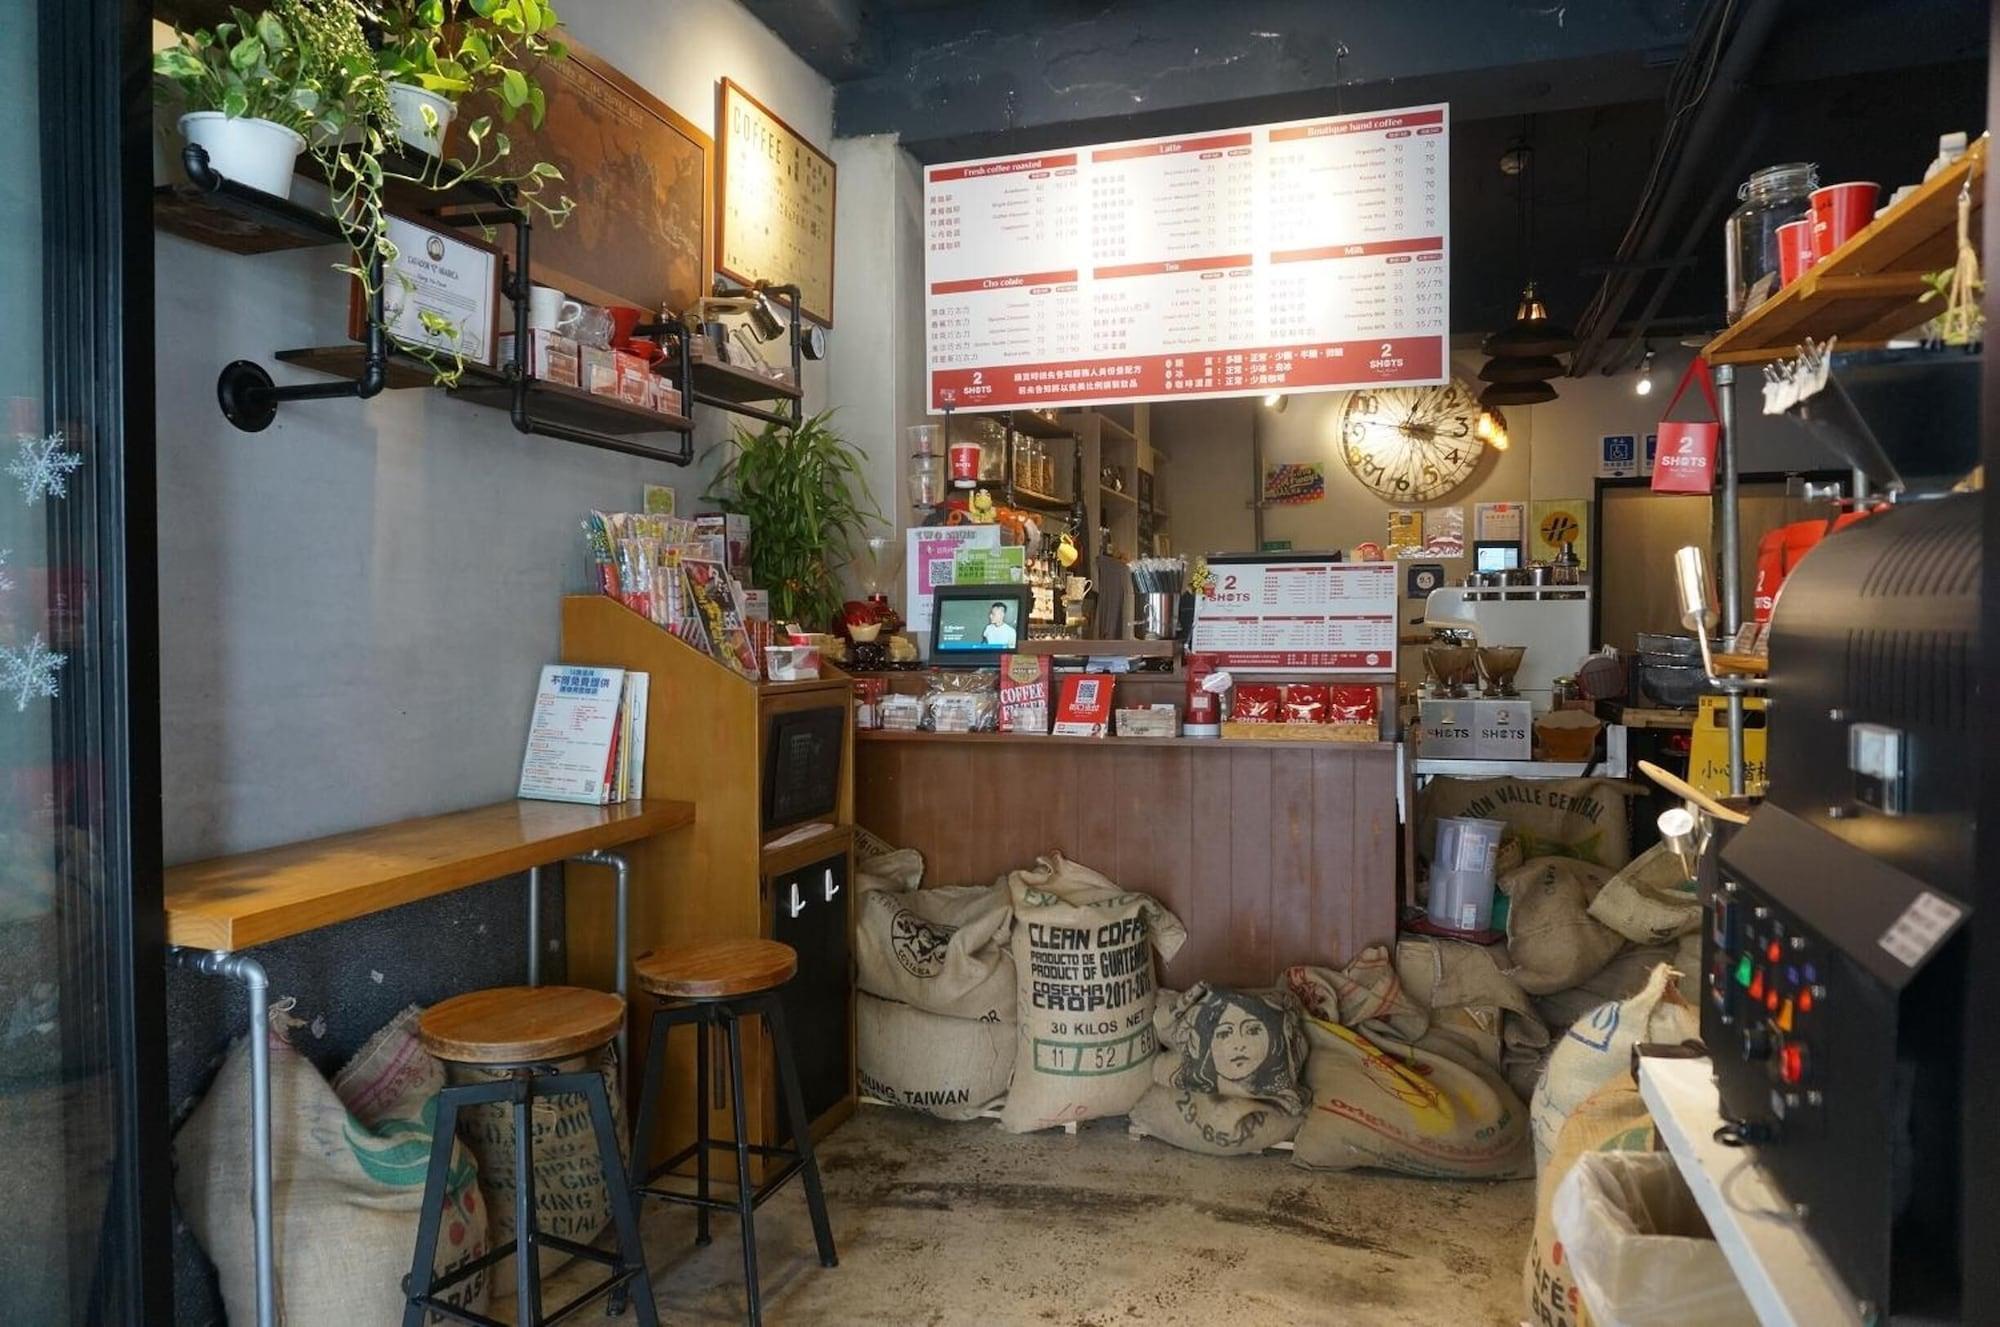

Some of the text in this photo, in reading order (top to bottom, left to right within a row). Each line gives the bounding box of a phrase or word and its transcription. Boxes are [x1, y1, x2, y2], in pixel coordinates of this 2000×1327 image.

[1350, 120, 1371, 132] hand
[1373, 117, 1402, 129] coffee
[733, 105, 782, 165] COFFEE
[1160, 142, 1181, 153] Latte
[964, 167, 985, 178] Fresh
[987, 163, 1010, 174] coffee
[1344, 246, 1364, 257] Milk
[1381, 344, 1391, 357] 2
[1369, 358, 1403, 369] SHOTS
[973, 372, 982, 384] 2
[963, 384, 992, 395] SHOTS
[1679, 437, 1692, 453] 2
[1661, 456, 1706, 467] SHOTS
[1224, 575, 1237, 590] 2
[1211, 592, 1250, 601] SHOTS
[1001, 681, 1046, 704] COFFEE
[1482, 729, 1525, 741] SHOTS
[1496, 785, 1542, 805] VALLE
[1029, 923, 1091, 950] CLEAN
[1030, 951, 1079, 965] PRODUCTO
[1082, 952, 1095, 965] DE
[1031, 963, 1097, 981] PRODUCT OF
[1033, 981, 1103, 996] COSECHA
[1033, 994, 1105, 1012] CROP
[1051, 1008, 1146, 1036] 30 KILOS NET
[1052, 1048, 1064, 1067] 11
[1095, 1048, 1115, 1068] 52
[904, 1088, 969, 1106] TAIWAN
